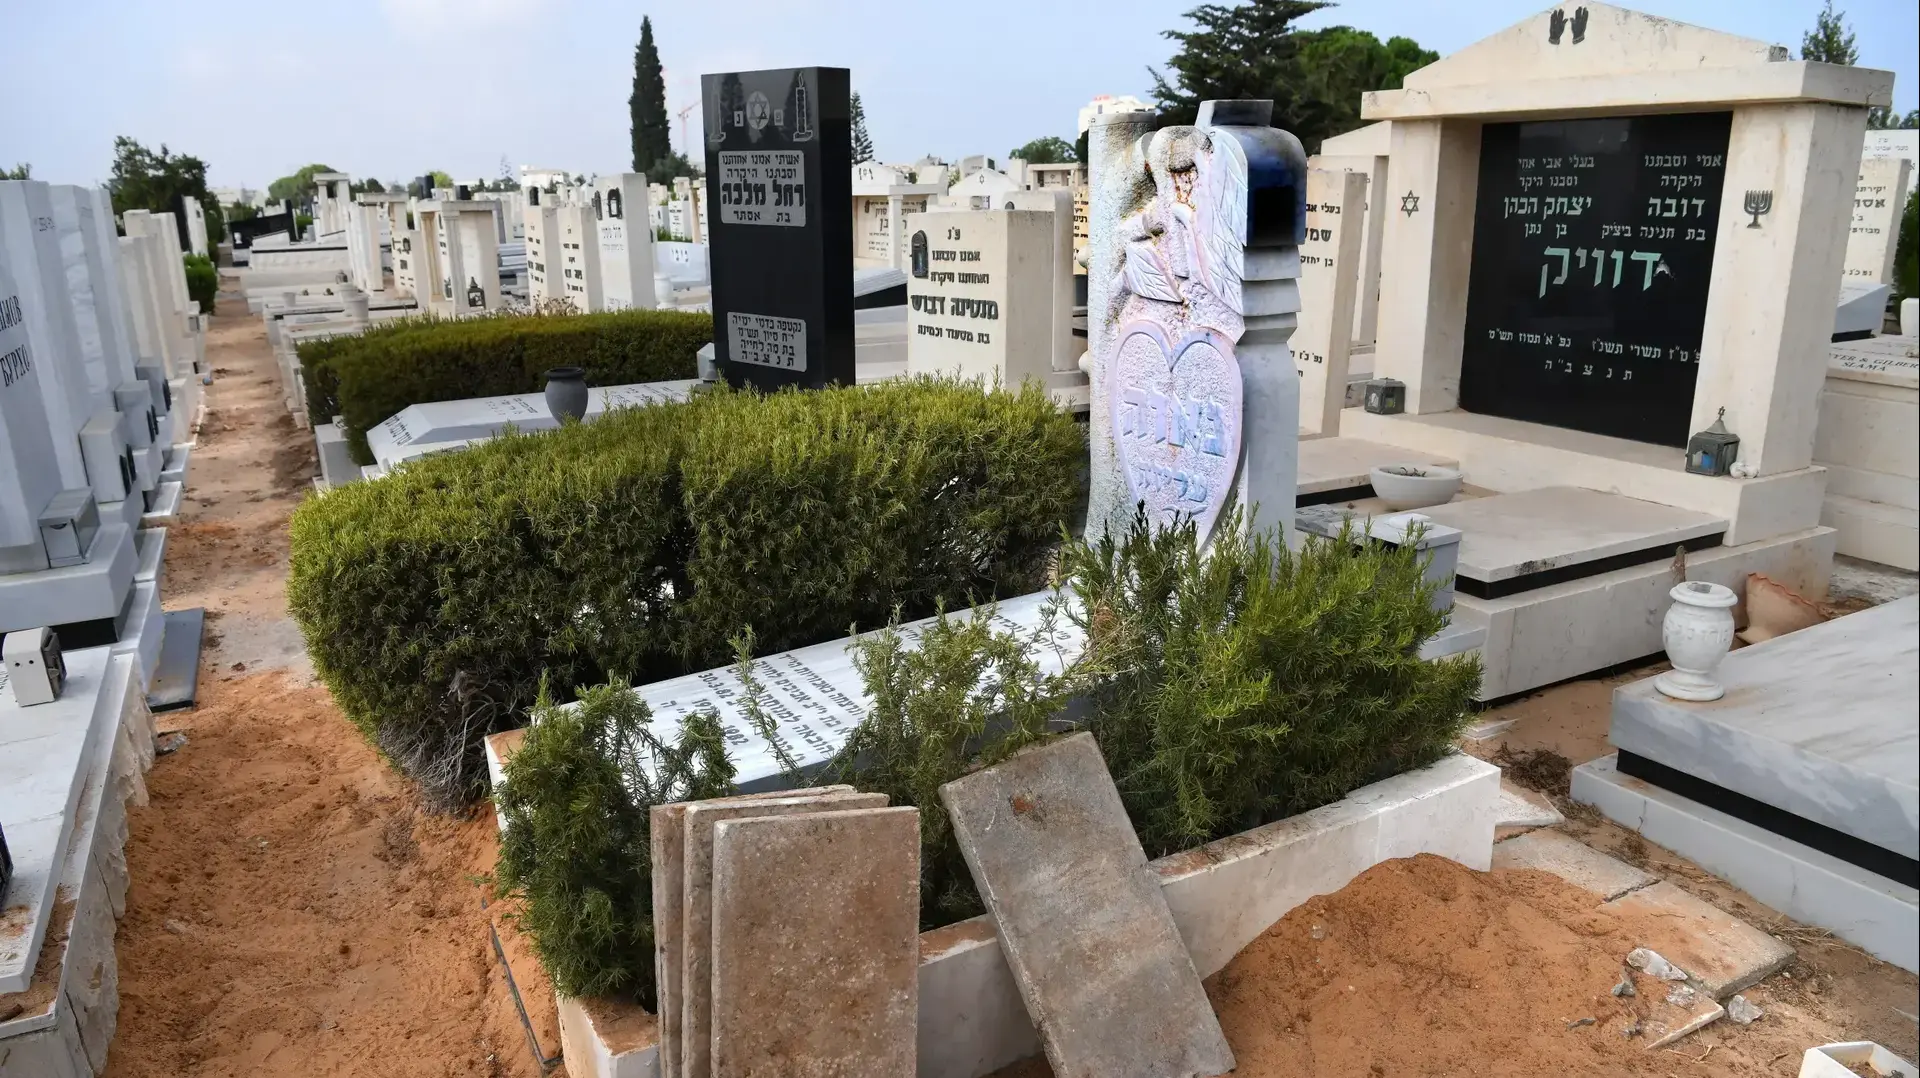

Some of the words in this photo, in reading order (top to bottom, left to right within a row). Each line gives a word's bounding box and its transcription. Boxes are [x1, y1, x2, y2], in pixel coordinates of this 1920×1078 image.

[722, 154, 748, 165] אחותנו
[751, 154, 771, 165] אמנו
[775, 154, 800, 165] אשתי
[1518, 157, 1536, 169] אחי
[1542, 157, 1562, 169] אבי
[1568, 154, 1595, 168] בעלי
[1644, 154, 1688, 167] וסבתנו
[1696, 154, 1722, 167] אמי
[726, 168, 758, 181] היקרה
[765, 168, 797, 179] וסבתנו
[1519, 176, 1543, 192] היקר
[1549, 175, 1578, 187] וסבנו
[1660, 174, 1702, 192] היקרה
[721, 179, 766, 206] מלכה
[772, 179, 804, 207] רחל
[1320, 202, 1341, 214] בעלי
[1503, 196, 1539, 219] הכהן
[1542, 195, 1592, 221] יצחק
[1647, 196, 1706, 218] דובה
[733, 210, 761, 221] אסתר
[776, 212, 791, 223] בת
[1524, 222, 1542, 238] נתן
[1555, 223, 1567, 239] בן
[1640, 225, 1675, 239] חנינה
[1685, 228, 1706, 241] בת
[959, 250, 981, 262] אמנו
[1324, 257, 1334, 268] בן
[957, 272, 990, 285] ואחותנו
[1539, 245, 1663, 299] דוויק
[930, 271, 955, 287] היקרה
[910, 294, 946, 315] דבוש
[732, 314, 751, 326] ימיה
[755, 317, 775, 329] בדמי
[777, 320, 802, 334] נקטפה
[945, 328, 974, 342] מסעוד
[976, 332, 991, 344] בת
[1518, 332, 1541, 344] תמוז
[740, 339, 765, 352] לחייה
[782, 345, 795, 356] בת
[1630, 344, 1661, 359] תשרי
[818, 714, 842, 728] בת
[791, 724, 835, 754] הובאה
